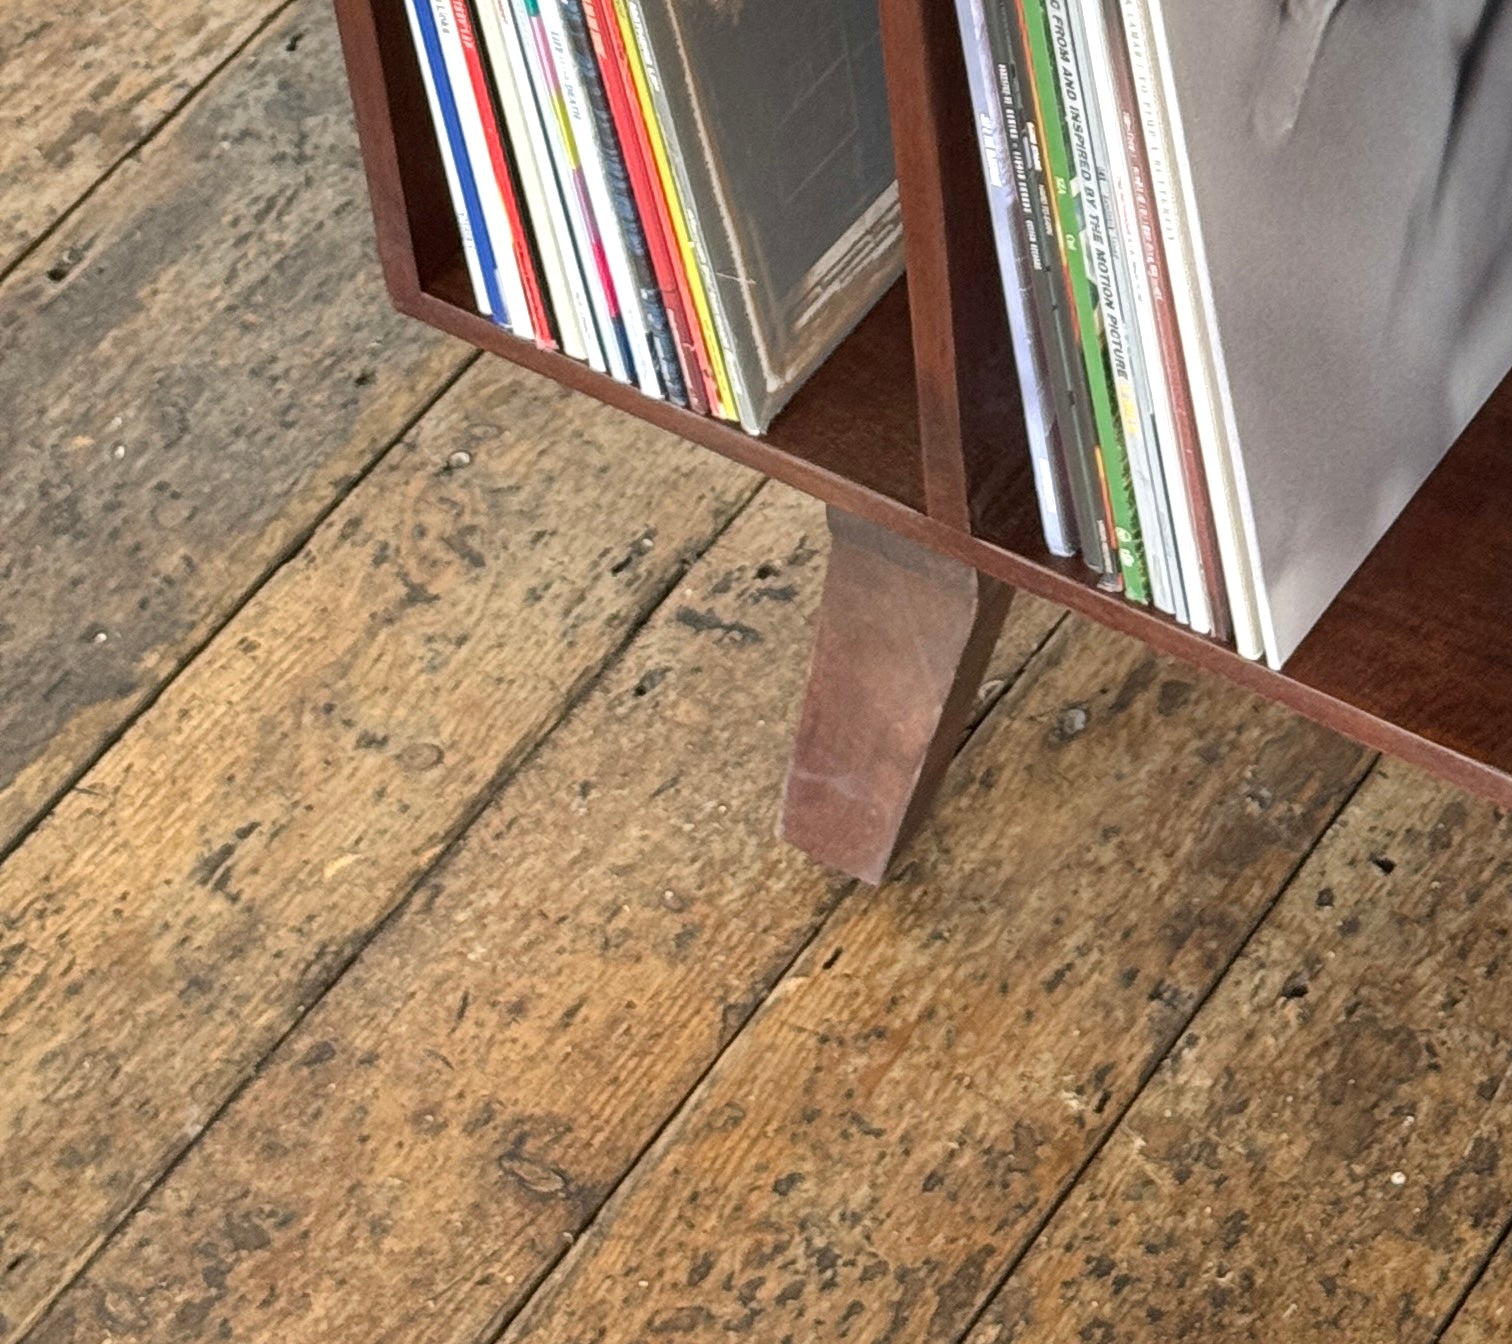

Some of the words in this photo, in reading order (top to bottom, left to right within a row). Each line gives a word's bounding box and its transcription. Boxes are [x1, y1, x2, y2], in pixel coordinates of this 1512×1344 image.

[1053, 15, 1070, 62] FROM
[1128, 13, 1141, 57] LAMAR
[1061, 66, 1077, 100] AND
[1071, 106, 1090, 180] INSPIRED
[1085, 186, 1095, 207] BY
[1090, 213, 1102, 241] THE
[1096, 248, 1114, 309] MOTION
[1107, 313, 1127, 379] PICTURE
